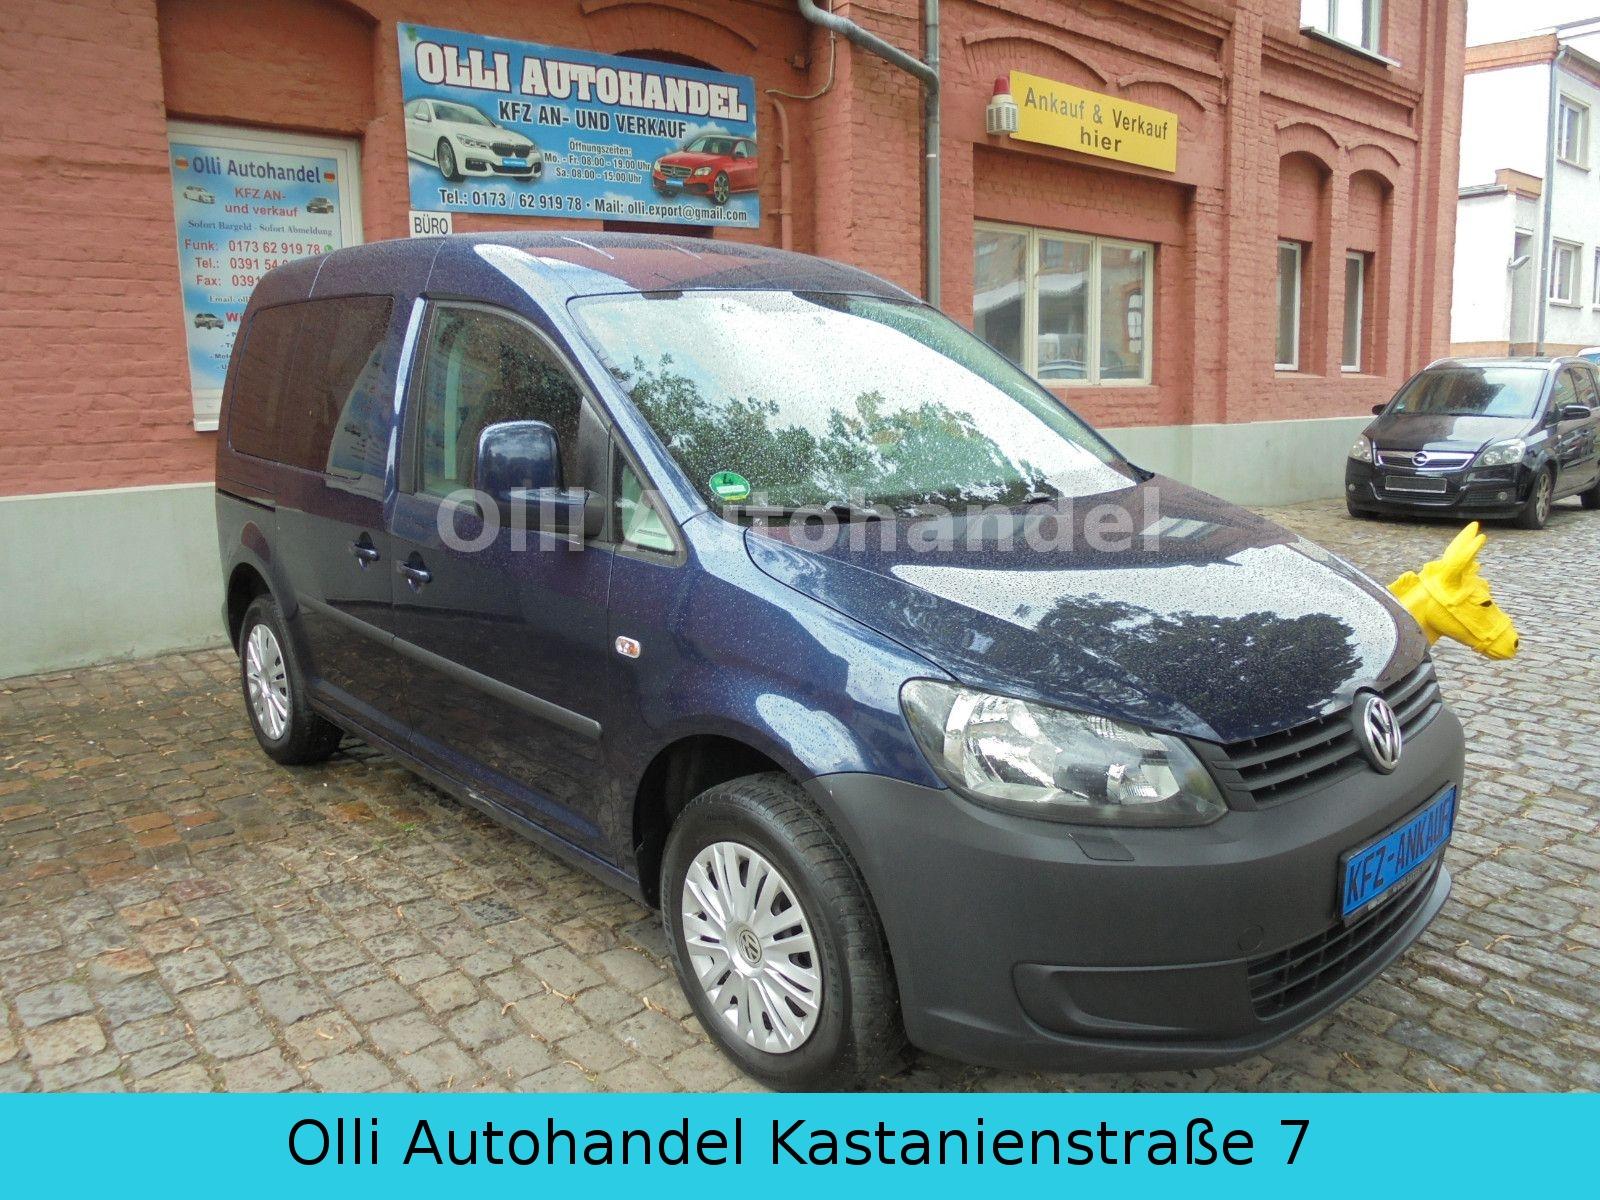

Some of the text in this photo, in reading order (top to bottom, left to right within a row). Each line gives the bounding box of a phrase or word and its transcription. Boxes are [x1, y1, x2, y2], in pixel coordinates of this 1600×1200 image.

[415, 40, 747, 122] OLLI AUTOHANDEL
[499, 101, 687, 139] KFZ AN- UND VERKAUF
[1024, 87, 1168, 140] Ankauf & Verkauf
[569, 139, 632, 156] Öffnungszeiten:
[1080, 127, 1122, 152] hier
[192, 156, 321, 183] Olli Autohandel
[544, 152, 560, 163] Mo.
[569, 154, 580, 164] Fr.
[613, 159, 635, 169] 19.00
[637, 161, 651, 171] Uhr
[628, 173, 642, 183] Uhr
[235, 187, 286, 201] KFZ AN-
[225, 203, 299, 217] und verkauf
[439, 188, 468, 206] Tel.:
[472, 190, 507, 207] 0173
[519, 194, 536, 208] 62
[539, 194, 564, 210] 919
[567, 197, 582, 211] 78
[594, 198, 624, 214] Mail:
[627, 200, 748, 222] olli.export@gmail.com
[188, 219, 216, 229] Sofort
[218, 221, 252, 232] Bargeld
[259, 223, 285, 233] Sofort
[287, 225, 333, 237] Abmeldung
[414, 213, 449, 235] BÜRO
[184, 238, 321, 255] Funk: 0173 62 919 78
[195, 257, 220, 269] Tel.:
[230, 257, 259, 270] 0391
[196, 274, 221, 286] Fax:
[1346, 799, 1450, 906] KFZ-ANKAUF
